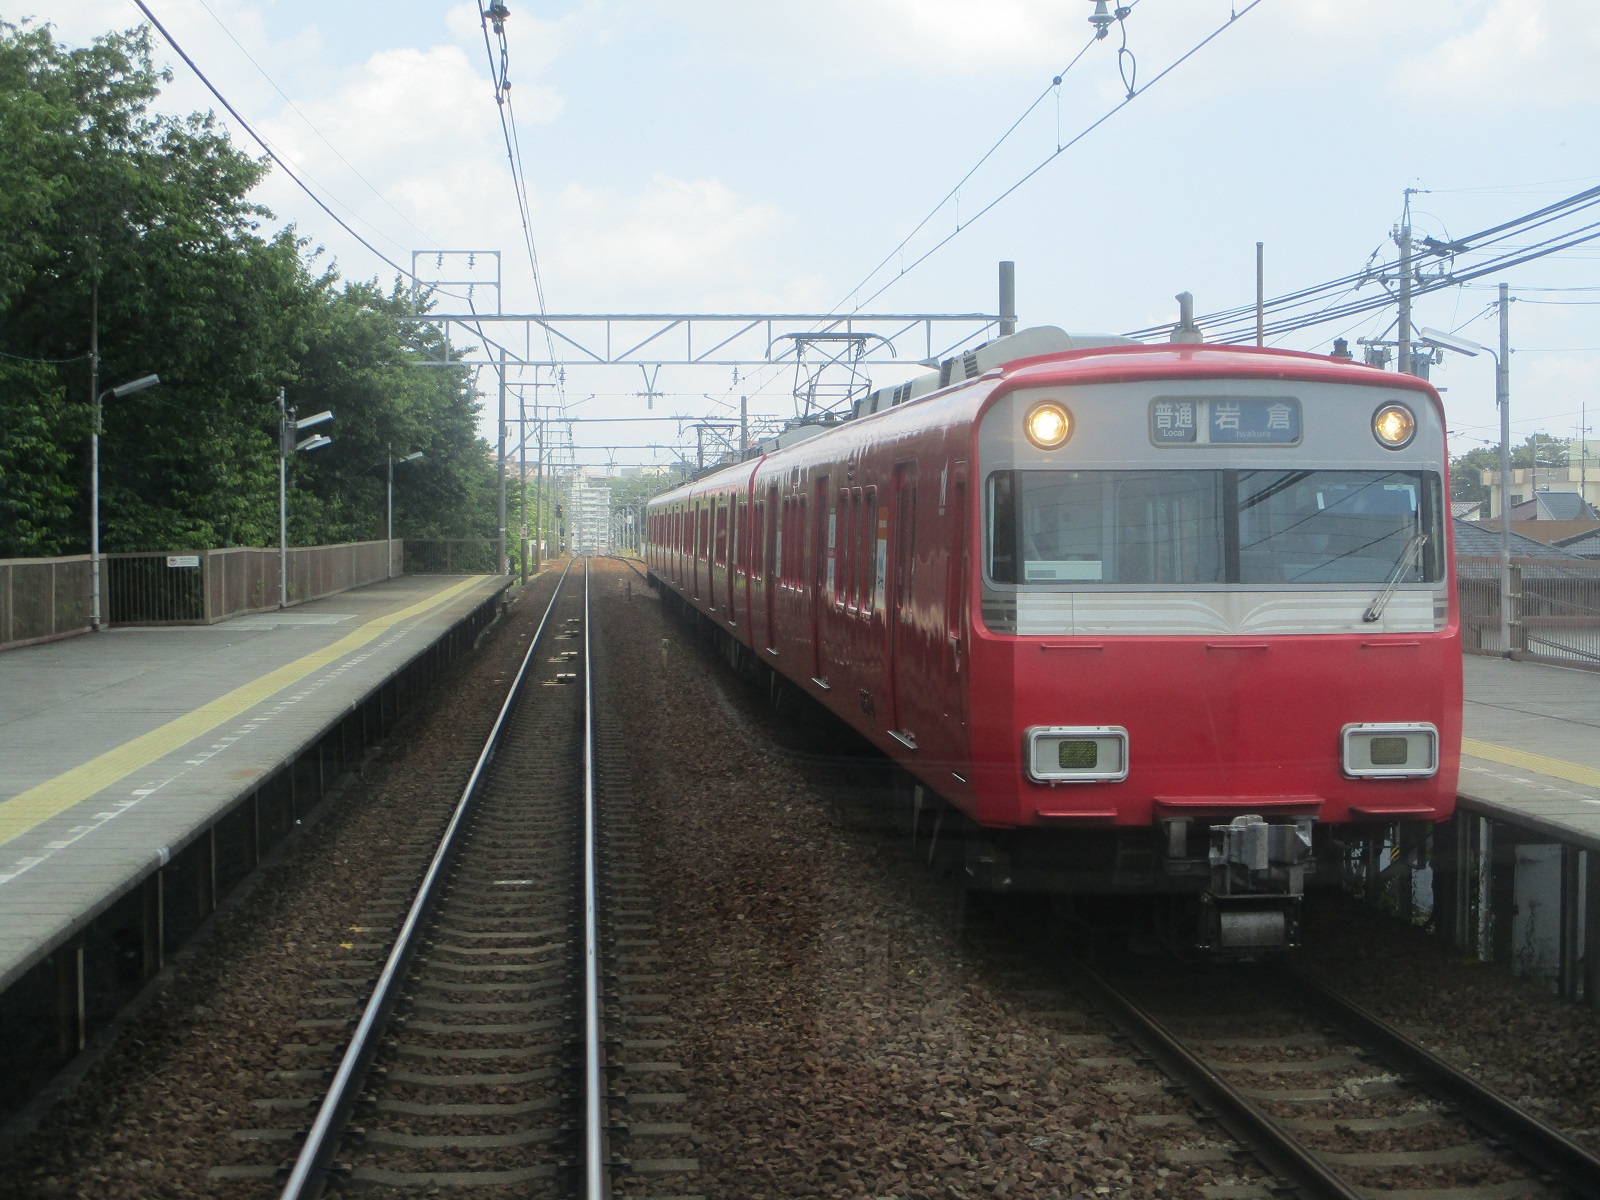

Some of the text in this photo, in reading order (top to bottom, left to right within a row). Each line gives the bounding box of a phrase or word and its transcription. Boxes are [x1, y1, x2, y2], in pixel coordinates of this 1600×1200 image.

[1155, 403, 1193, 429] 普通
[1163, 429, 1185, 437] Local
[1236, 430, 1271, 438] Iwakura
